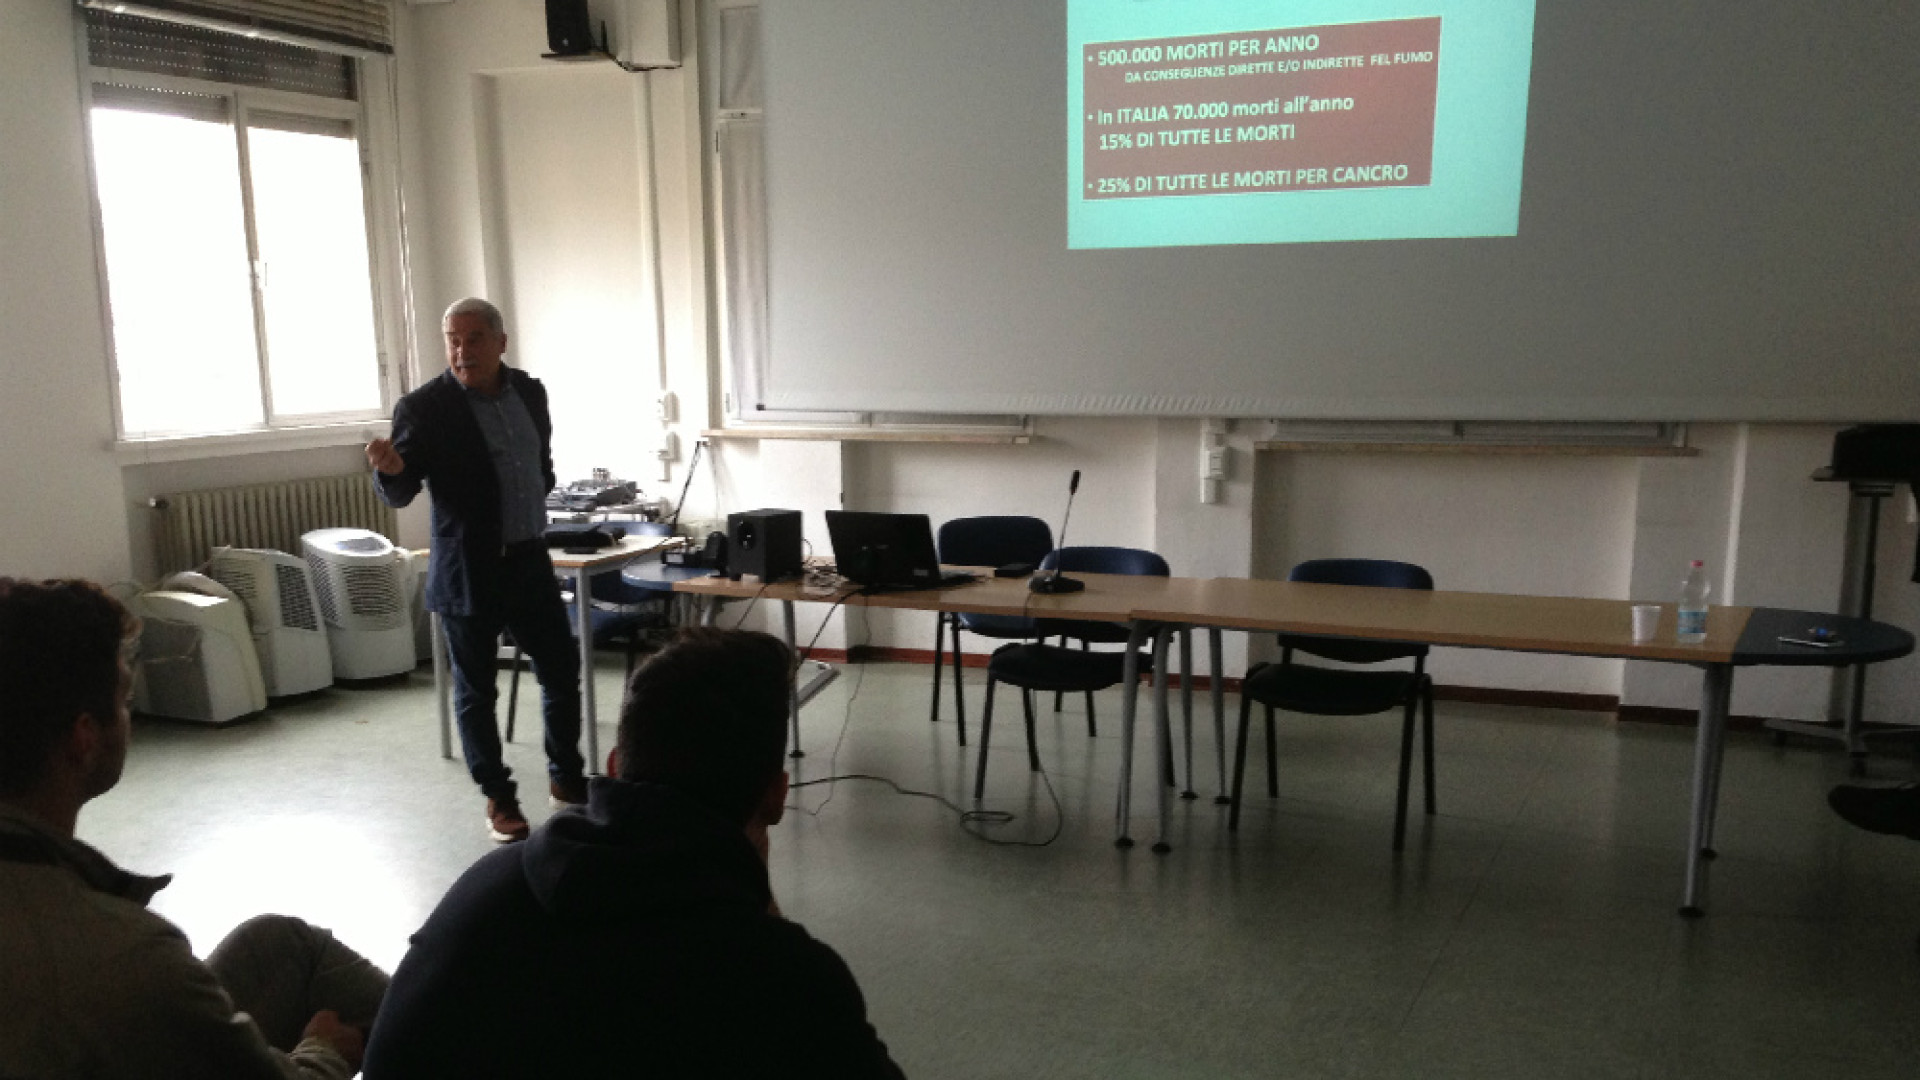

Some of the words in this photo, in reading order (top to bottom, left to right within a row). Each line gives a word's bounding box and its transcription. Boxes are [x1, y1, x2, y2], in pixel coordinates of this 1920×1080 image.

[1098, 46, 1162, 66] 500.000
[1166, 42, 1224, 61] MORTI
[1229, 39, 1260, 57] PER
[1265, 34, 1320, 54] ANNO
[1125, 71, 1141, 83] DA
[1144, 65, 1225, 81] CONSEGUENZE
[1228, 61, 1274, 75] DIRETTE
[1278, 59, 1300, 73] E/O
[1303, 55, 1364, 70] INDIRETTE
[1370, 54, 1390, 66] FEL
[1394, 51, 1433, 64] FUMO
[1097, 109, 1112, 125] In
[1117, 105, 1169, 124] ITALIA
[1173, 101, 1229, 120] 70.000
[1233, 98, 1279, 116] morti
[1100, 133, 1132, 150] 15%
[1137, 131, 1153, 148] DI
[1158, 128, 1210, 146] TUTTE
[1214, 127, 1232, 144] LE
[1237, 124, 1295, 142] MORTI
[1097, 177, 1131, 193] 25%
[1135, 175, 1152, 192] DI
[1156, 173, 1208, 190] TUTTE
[1212, 172, 1229, 188] LE
[1234, 169, 1291, 187] MORTI
[1296, 168, 1327, 184] PER
[1332, 164, 1408, 183] CANCRO
